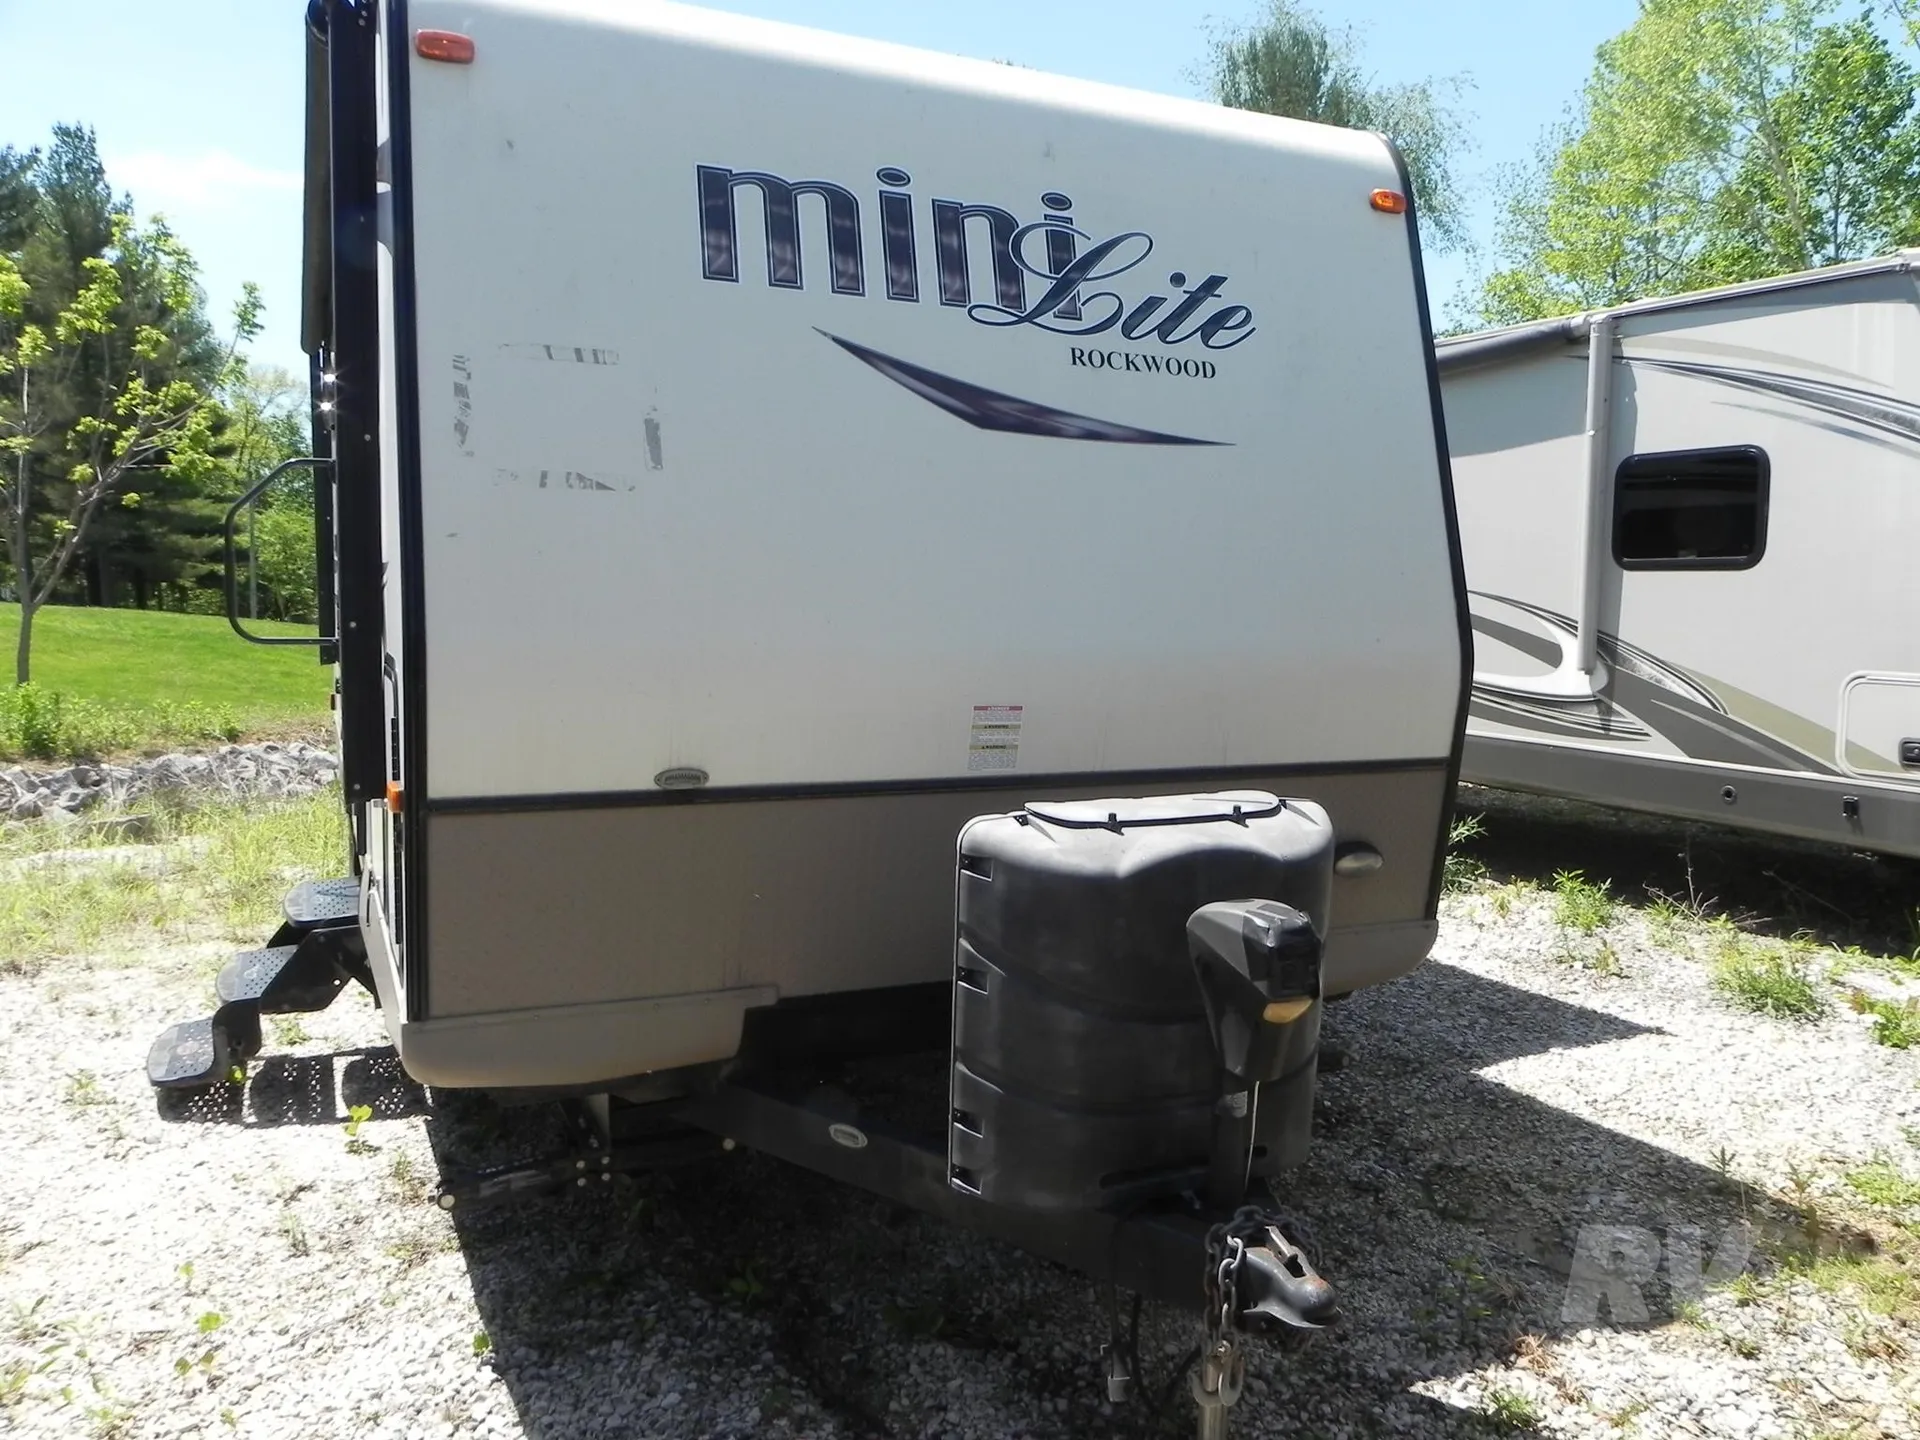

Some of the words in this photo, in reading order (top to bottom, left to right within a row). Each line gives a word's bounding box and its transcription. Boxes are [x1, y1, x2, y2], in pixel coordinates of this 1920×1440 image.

[697, 163, 1082, 321] mini
[967, 221, 1256, 350] Lite
[1070, 347, 1216, 379] ROCKWOOD
